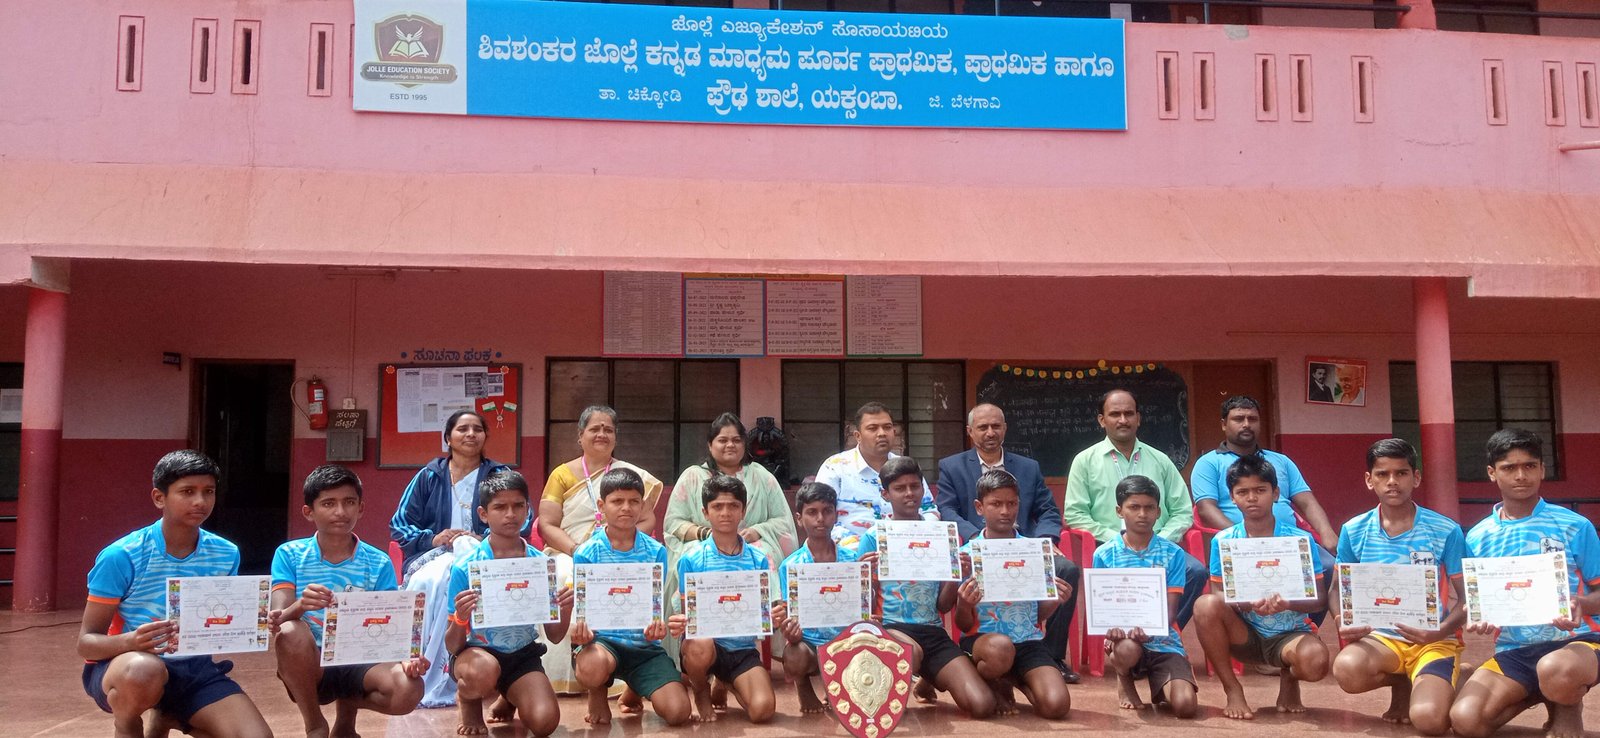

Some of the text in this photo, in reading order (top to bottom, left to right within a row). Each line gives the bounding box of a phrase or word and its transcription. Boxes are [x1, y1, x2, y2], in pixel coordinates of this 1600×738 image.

[671, 15, 949, 42] ಜೊಲ್ಲೆ ಎಜ್ಯೂಕೇಶನ್ ಸೊಸಾಯಟಿಯ
[367, 65, 450, 75] JOLLE EDUCATION SOCIETY
[478, 34, 1115, 83] ಶಿವಶಂಕರ ಜೊಲ್ಲೆ ಕನ್ನಡ ಮಾಧ್ಯಮ ಪೂರ್ವ ಪ್ರಾಥಮಿಕ, ಪ್ರಾಥಮಿಕ ಹಾಗೂ
[598, 79, 1001, 119] ತಾ. ಚಿಕ್ಕೋಡಿ ಪ್ರೌಢ ಶಾಲೆ, ಯಕ್ಸಂಬಾ. ಜಿ. ಬೆಳಗಾವಿ
[413, 348, 461, 361] ಸೂಚನಾ
